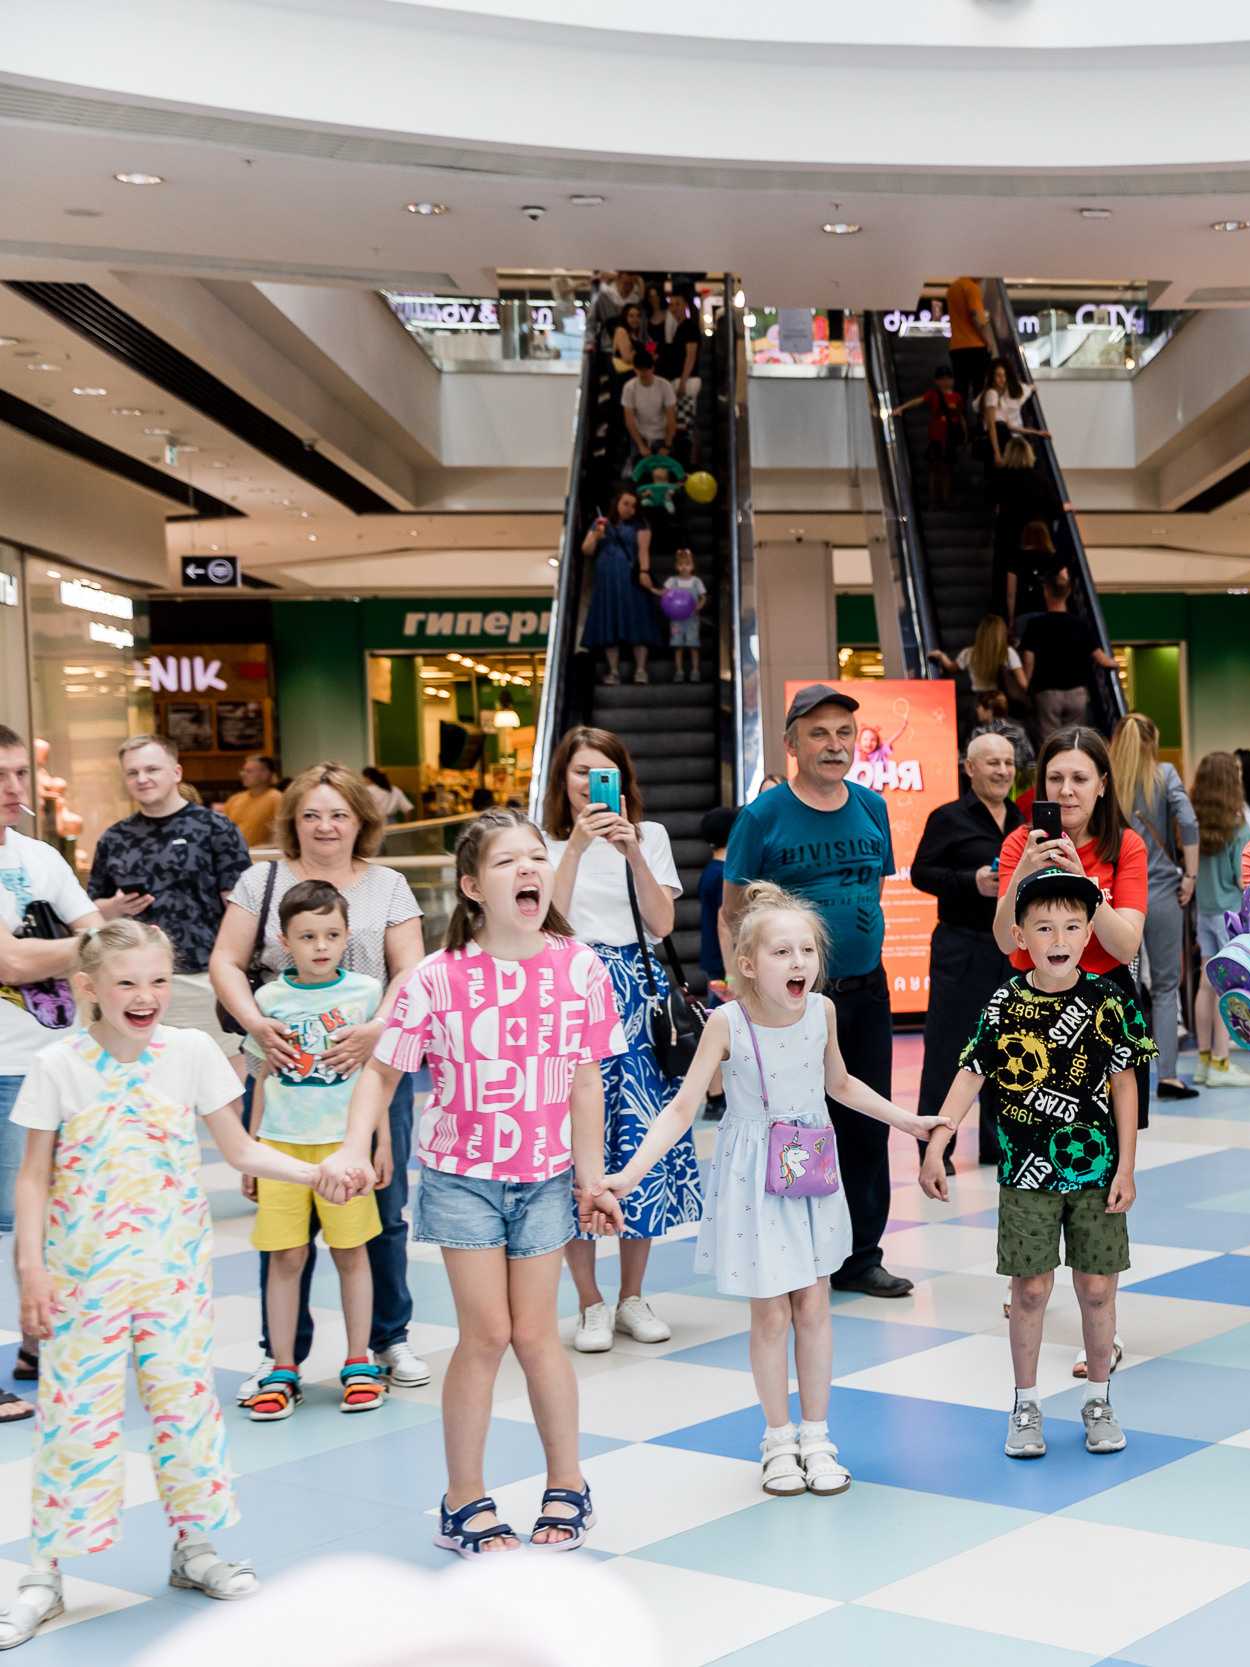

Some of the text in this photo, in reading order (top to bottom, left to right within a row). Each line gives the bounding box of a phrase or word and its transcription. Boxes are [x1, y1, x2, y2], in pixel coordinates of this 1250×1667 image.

[1075, 304, 1138, 334] CTY
[845, 760, 923, 791] ОНЯ
[466, 967, 486, 1009] FILA
[538, 967, 555, 1008] FILA
[319, 1008, 347, 1033] BE
[538, 1013, 554, 1055] FILA
[466, 1123, 484, 1160] FILA
[532, 1126, 547, 1167] FILA
